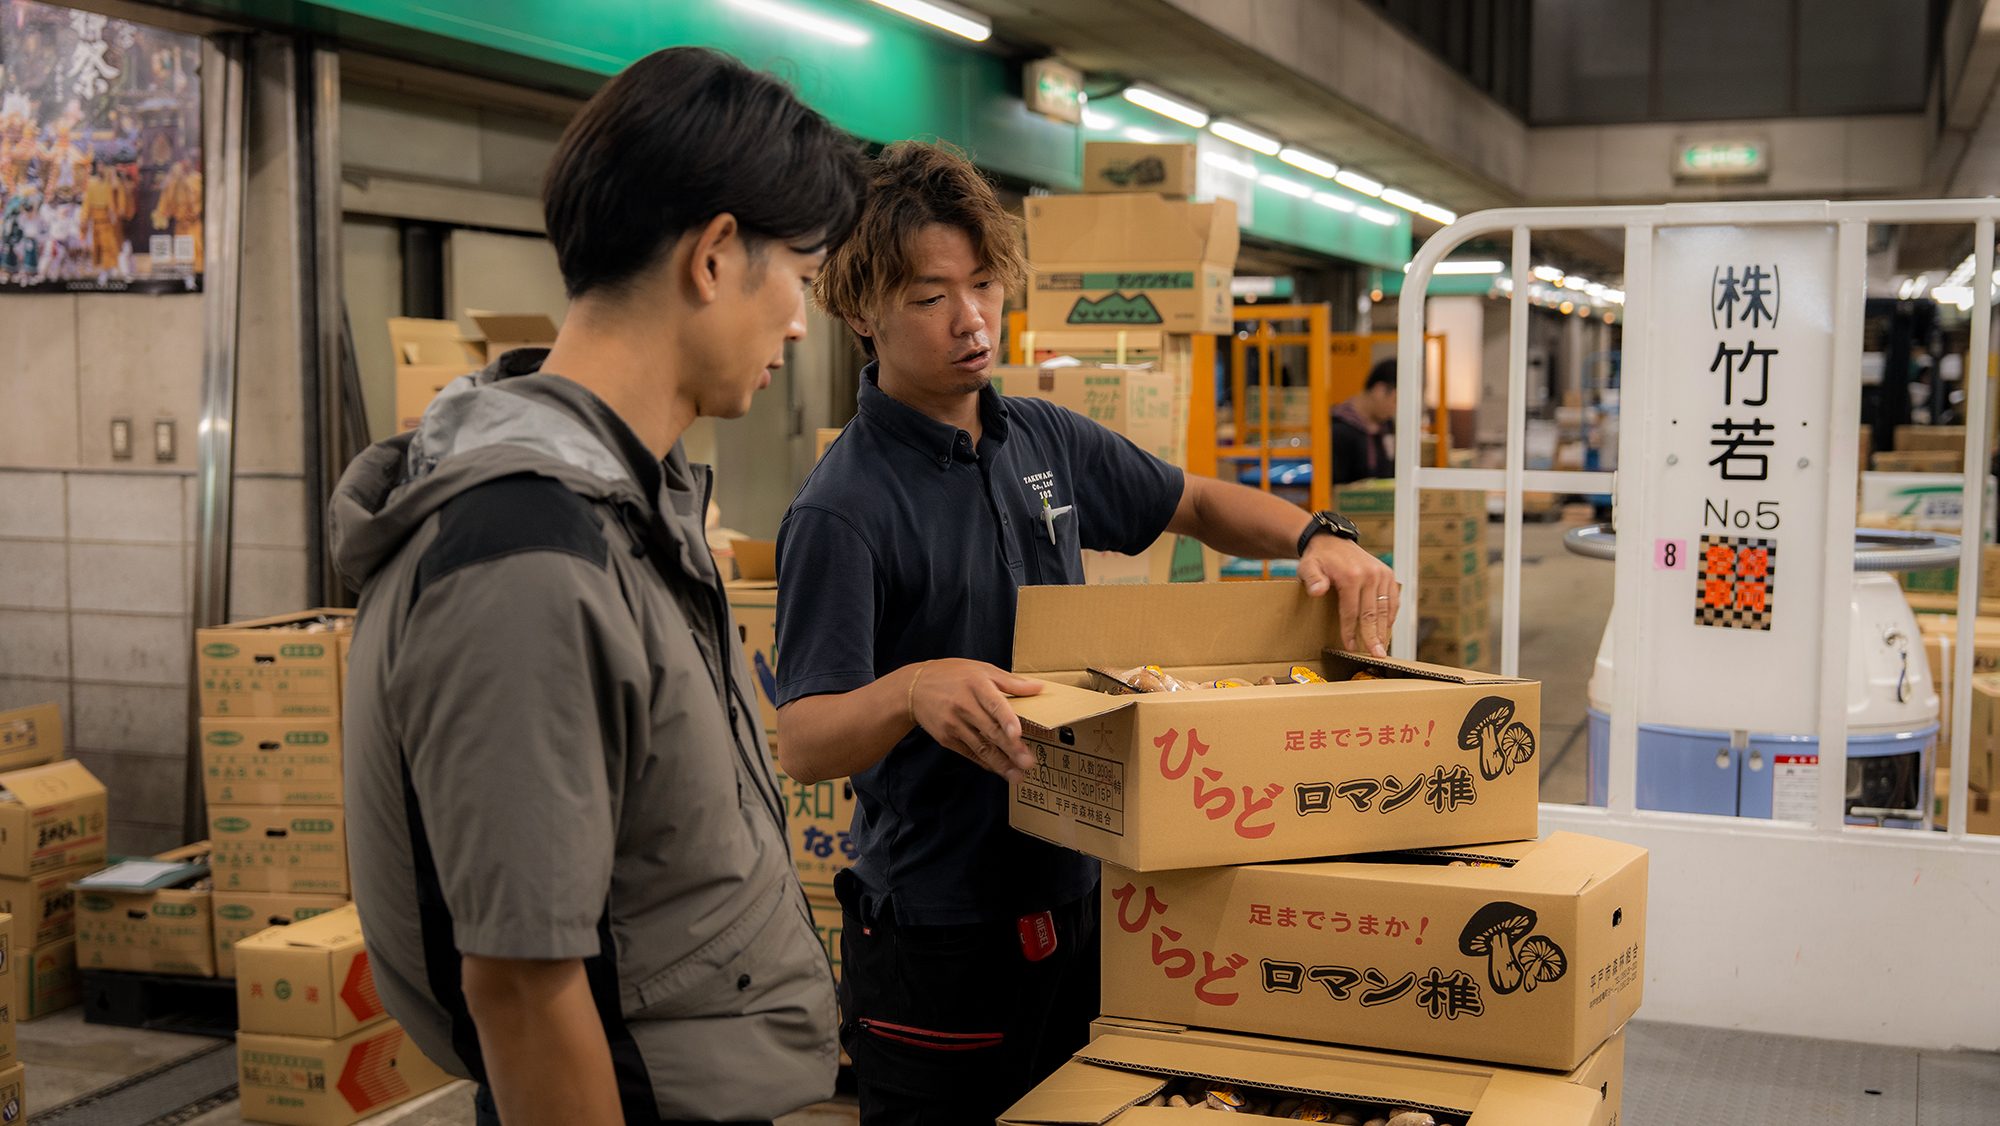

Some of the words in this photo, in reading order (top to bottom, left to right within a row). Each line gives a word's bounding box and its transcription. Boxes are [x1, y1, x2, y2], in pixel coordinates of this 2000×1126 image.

[1664, 542, 1677, 567] 8
[1153, 727, 1285, 840] ひらど
[1035, 917, 1049, 949] DIESEL
[1111, 882, 1249, 1007] ひらど
